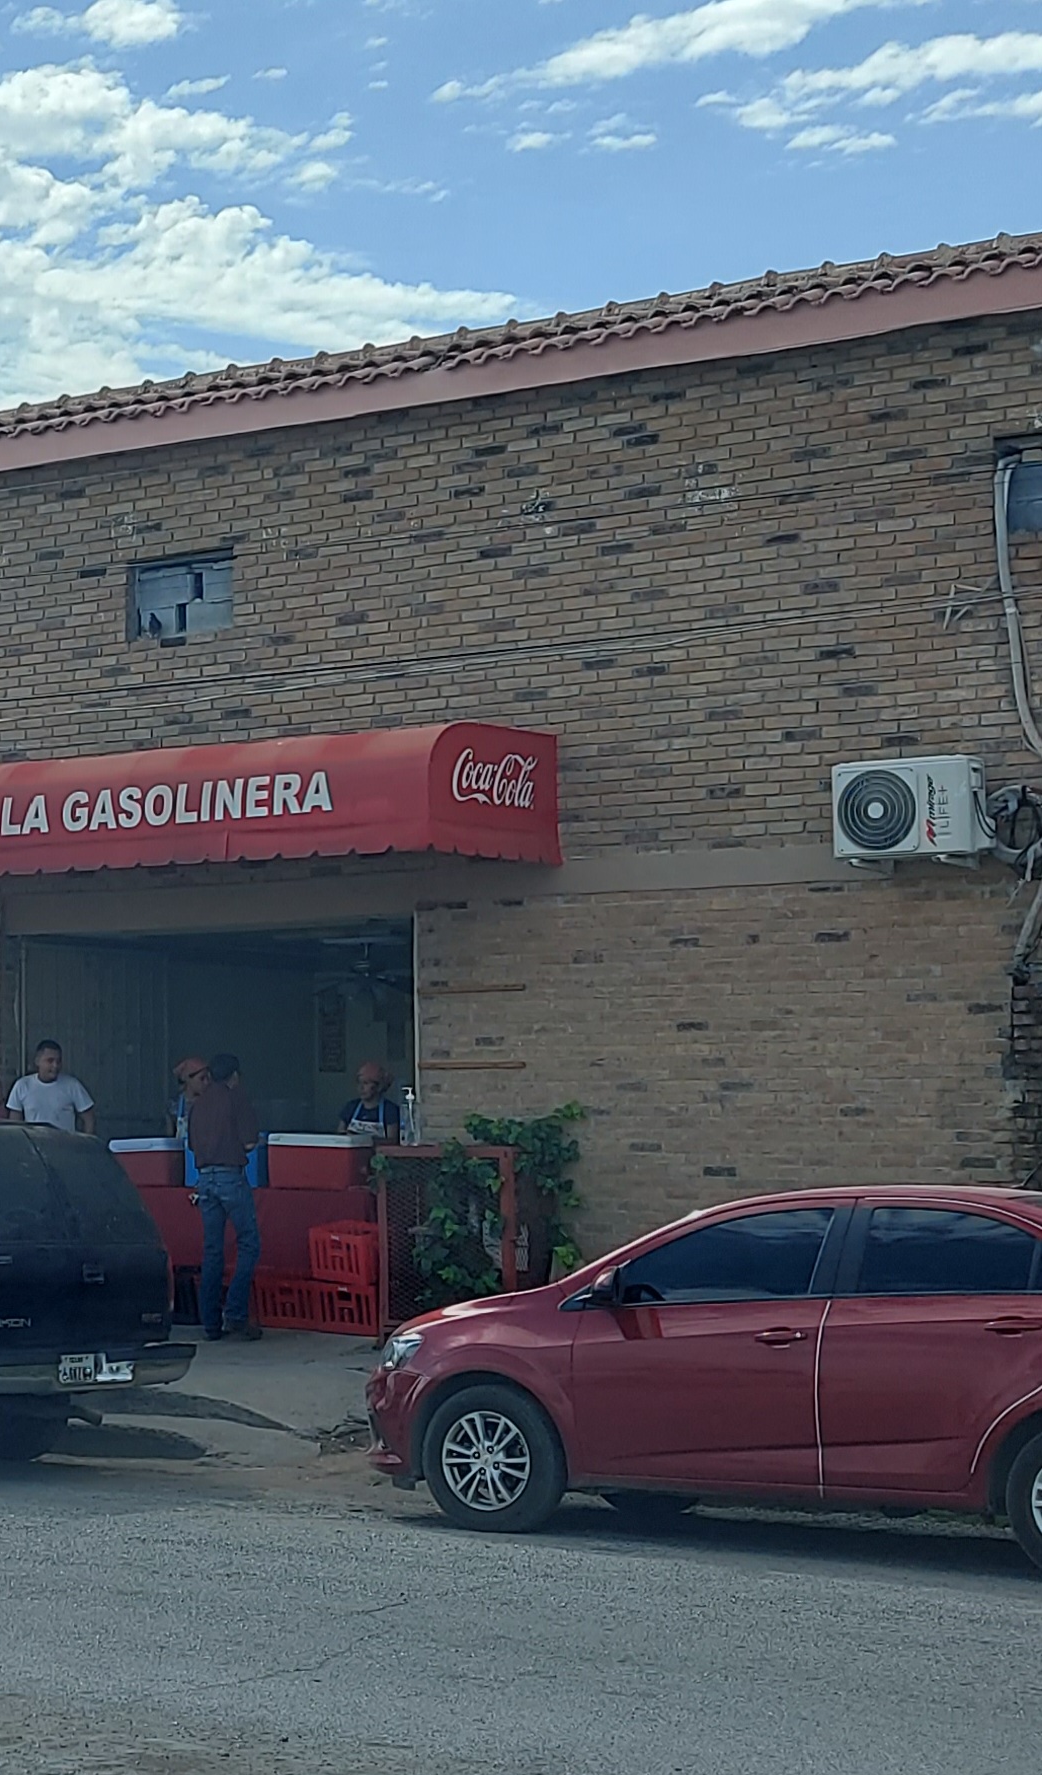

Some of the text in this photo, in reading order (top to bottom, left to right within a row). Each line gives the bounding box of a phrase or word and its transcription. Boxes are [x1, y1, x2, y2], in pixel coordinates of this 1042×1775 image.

[0, 794, 49, 836] LA
[62, 770, 333, 832] GASOLINERA
[452, 747, 538, 809] Coca-Cola
